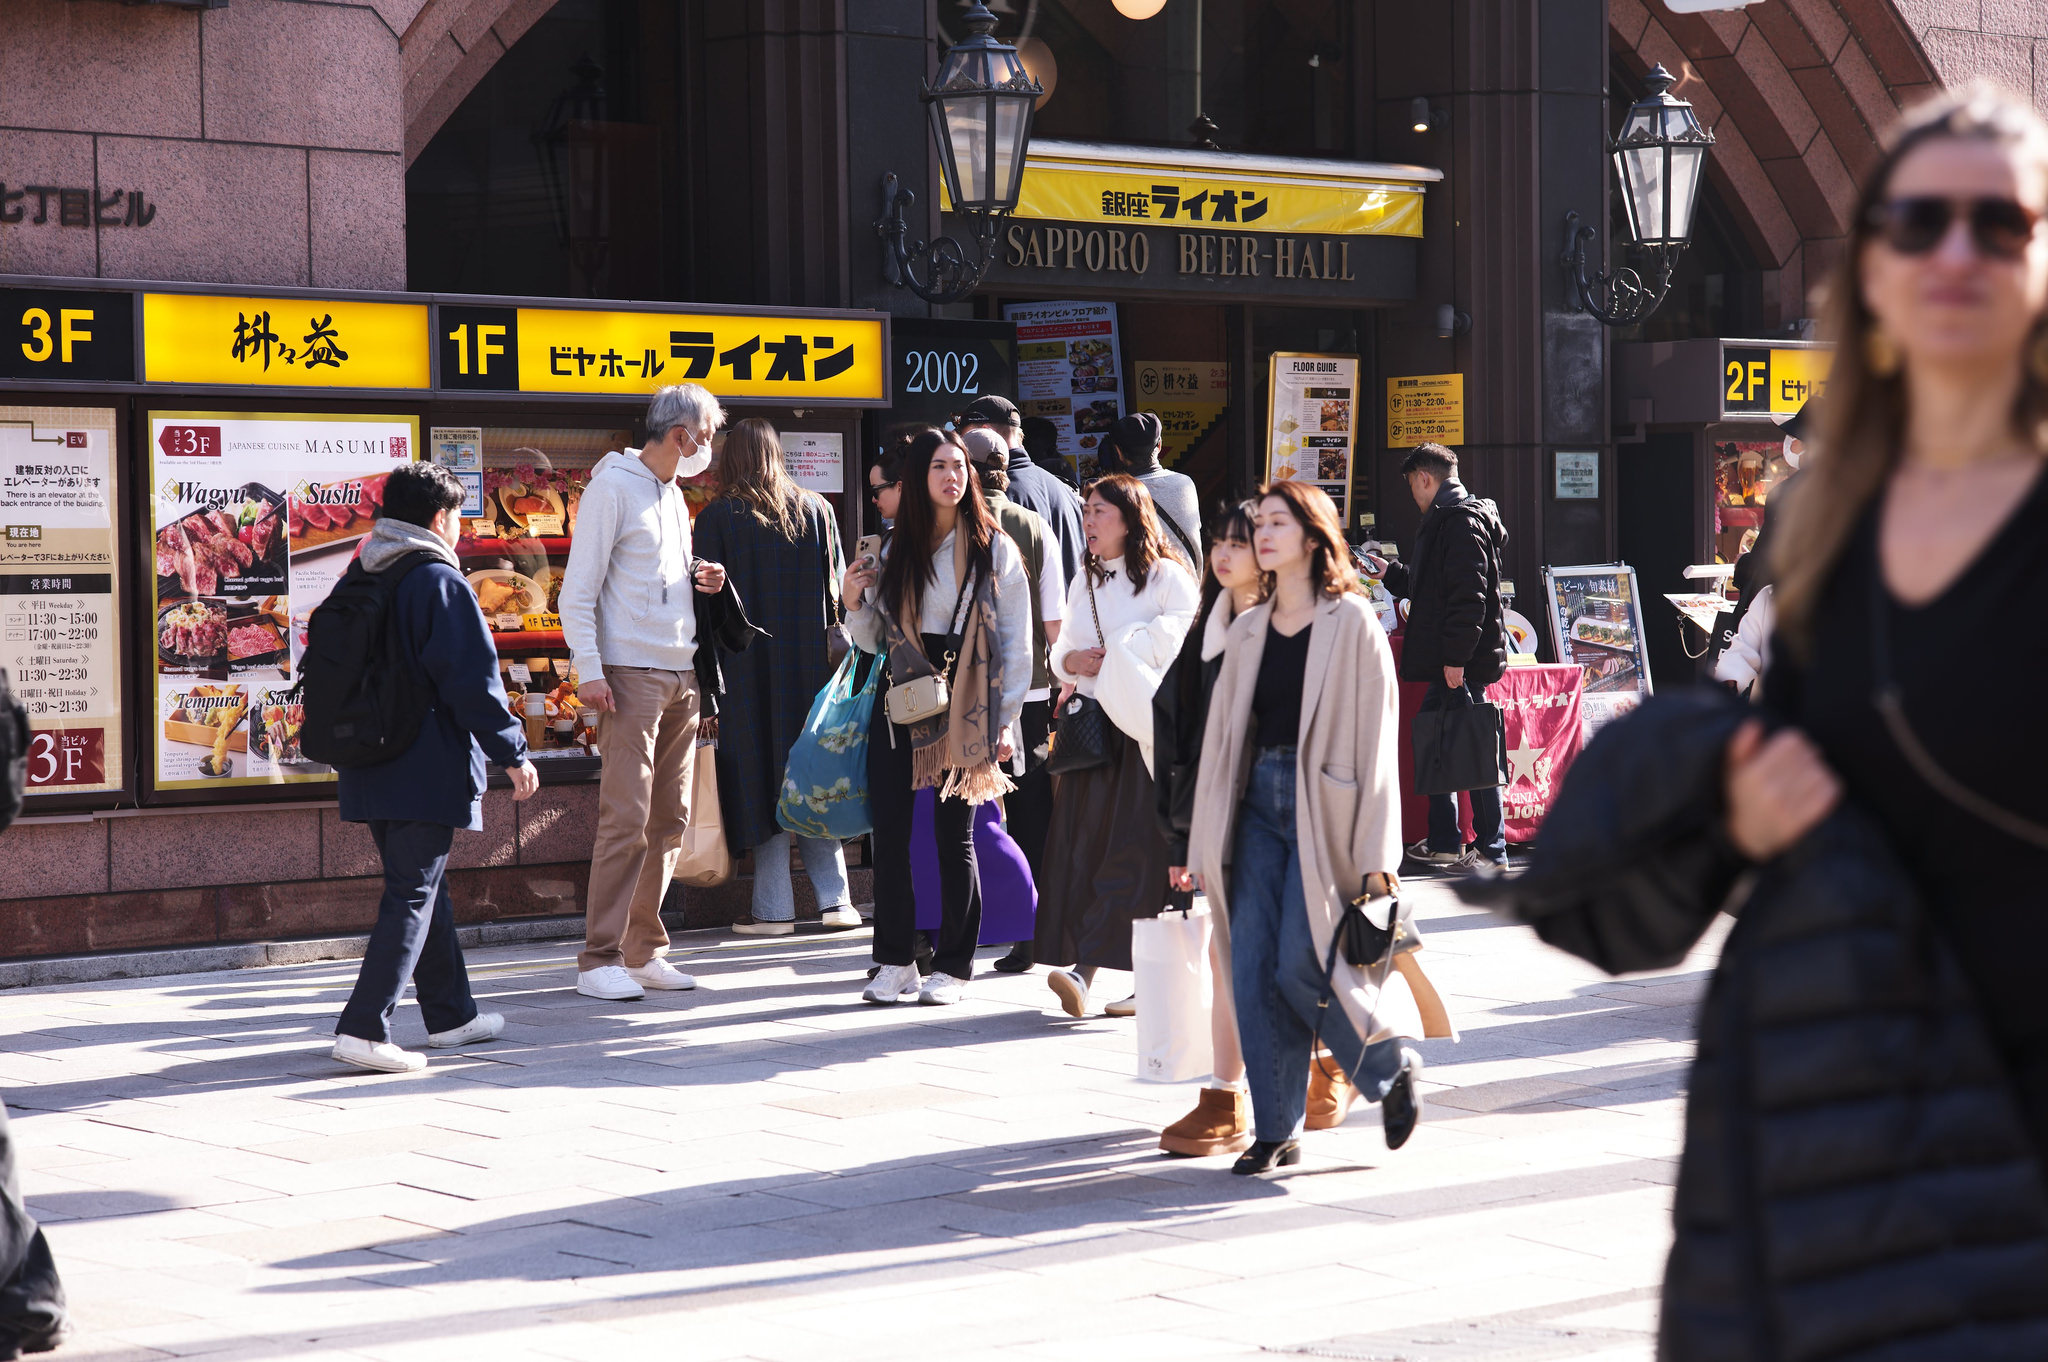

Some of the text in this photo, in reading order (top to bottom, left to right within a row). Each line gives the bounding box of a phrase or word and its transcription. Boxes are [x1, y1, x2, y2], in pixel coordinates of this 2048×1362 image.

[1101, 185, 1268, 222] 銀座ライオン
[1006, 225, 1356, 281] SAPPORO BEER-HALL
[21, 307, 94, 363] 3F
[449, 323, 507, 375] 1F
[905, 350, 979, 394] 2002
[1293, 362, 1338, 373] FLOOR GUIDE
[1143, 370, 1156, 388] 3F
[1726, 361, 1766, 401] 2F
[1393, 397, 1402, 408] 1F
[1163, 420, 1199, 431] ライオン
[1393, 425, 1402, 436] 2F
[70, 436, 84, 444] EV
[183, 428, 210, 454] 3F
[228, 442, 266, 451] JAPANESE
[268, 442, 301, 451] CUISINE
[305, 439, 386, 455] MASUMI
[15, 465, 89, 476] 建物反対の入口に
[4, 477, 101, 488] エレベーターがあります
[177, 481, 246, 511] Wagyu
[306, 482, 362, 506] Sushi
[76, 499, 104, 508] building.
[10, 527, 39, 538] 現在地
[31, 579, 72, 590] 営業時間
[1563, 581, 1585, 593] ビール
[32, 601, 73, 610] 平日 Weekday
[28, 612, 97, 625] 11:30～15:00
[28, 628, 97, 641] 17:00～22:00
[29, 656, 51, 665] 土曜日
[19, 668, 88, 681] 11:30～22:30
[65, 689, 87, 697] Holiday
[177, 692, 240, 712] Tempura
[61, 735, 88, 747] 当ビル
[30, 733, 83, 783] 3F
[1510, 790, 1540, 804] GINZA
[1503, 802, 1545, 820] LION
